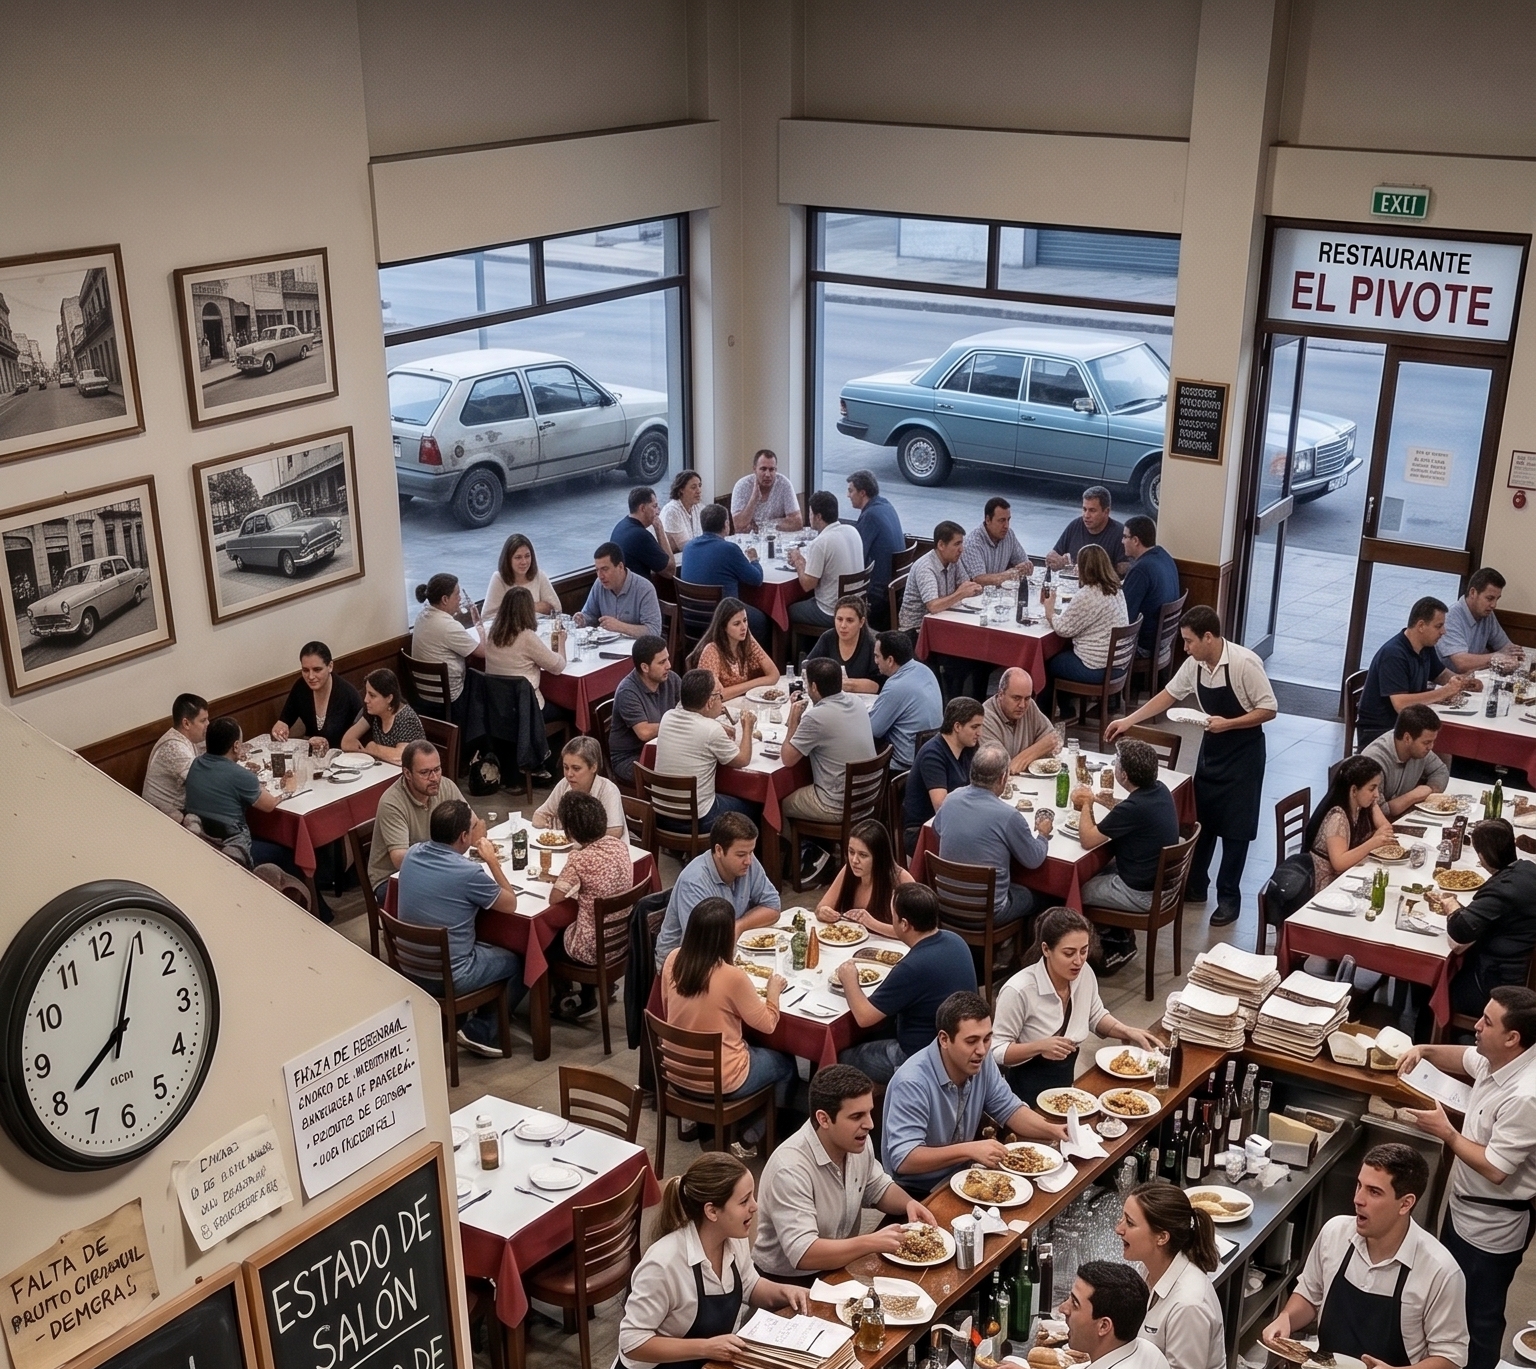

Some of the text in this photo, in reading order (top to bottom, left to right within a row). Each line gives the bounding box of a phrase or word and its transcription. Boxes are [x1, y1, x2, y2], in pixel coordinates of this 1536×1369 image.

[1318, 242, 1472, 275] RESTAURANTE
[1291, 270, 1493, 326] EL PIVOTE
[88, 931, 115, 961] 12
[133, 930, 144, 955] 1
[57, 960, 79, 990] 11
[161, 950, 176, 976] 2
[176, 987, 191, 1012] 3
[36, 1003, 62, 1032] 10
[172, 1032, 186, 1056] 4
[34, 1054, 50, 1079] 9
[153, 1074, 167, 1100] 5
[52, 1091, 69, 1116] 8
[121, 1104, 136, 1128] 6
[85, 1107, 99, 1134] 7
[10, 1236, 109, 1304] FALTA DE
[271, 1193, 432, 1335] ESTADO DE
